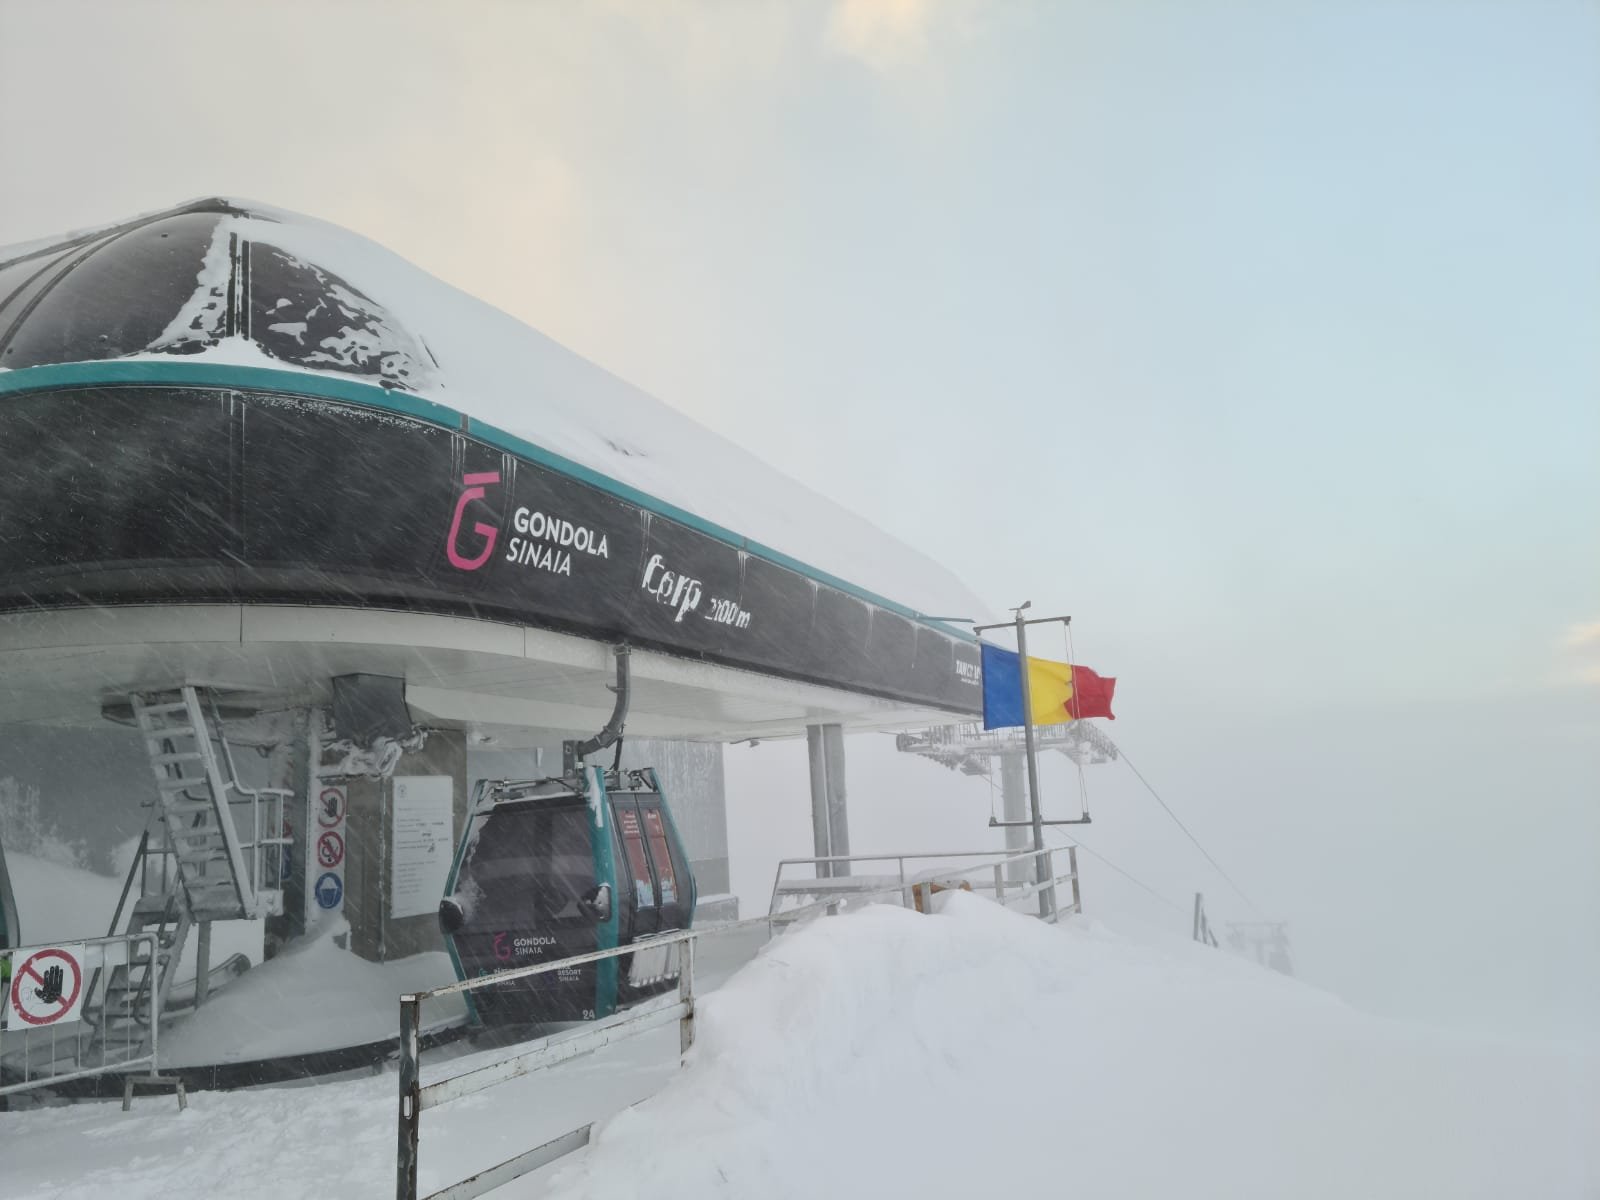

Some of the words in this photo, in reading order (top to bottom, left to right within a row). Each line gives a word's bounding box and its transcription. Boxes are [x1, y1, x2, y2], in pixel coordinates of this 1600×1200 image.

[513, 506, 609, 559] GONDOLA
[505, 537, 571, 576] SINAIA
[514, 937, 556, 947] GONDOLA
[515, 947, 543, 955] SINAIA
